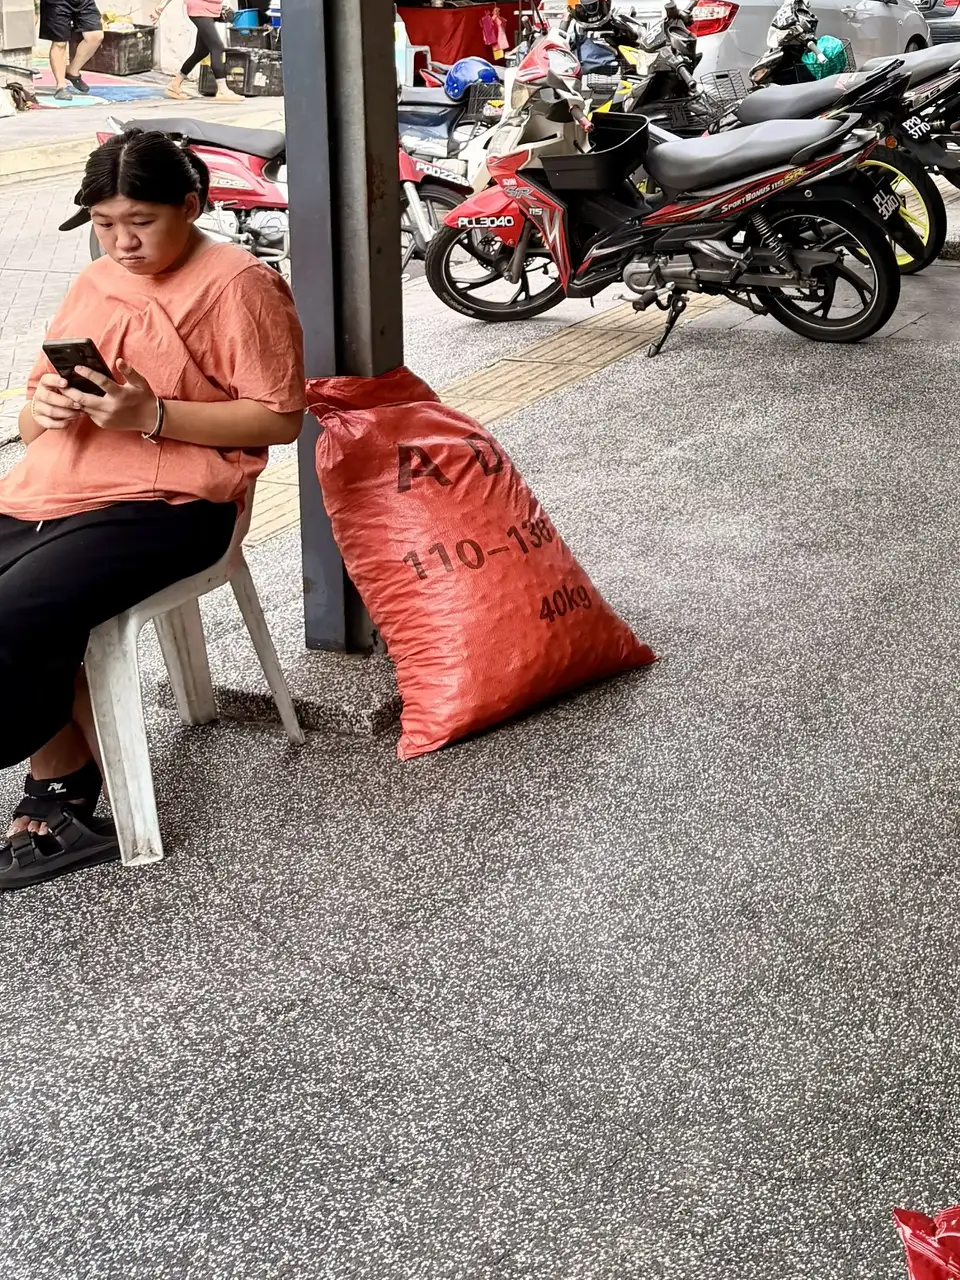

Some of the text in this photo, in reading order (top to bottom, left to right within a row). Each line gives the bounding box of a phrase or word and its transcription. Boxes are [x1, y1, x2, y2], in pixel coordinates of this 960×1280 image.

[397, 443, 453, 494] A
[402, 518, 553, 581] 110-138
[539, 583, 592, 624] 40kg
